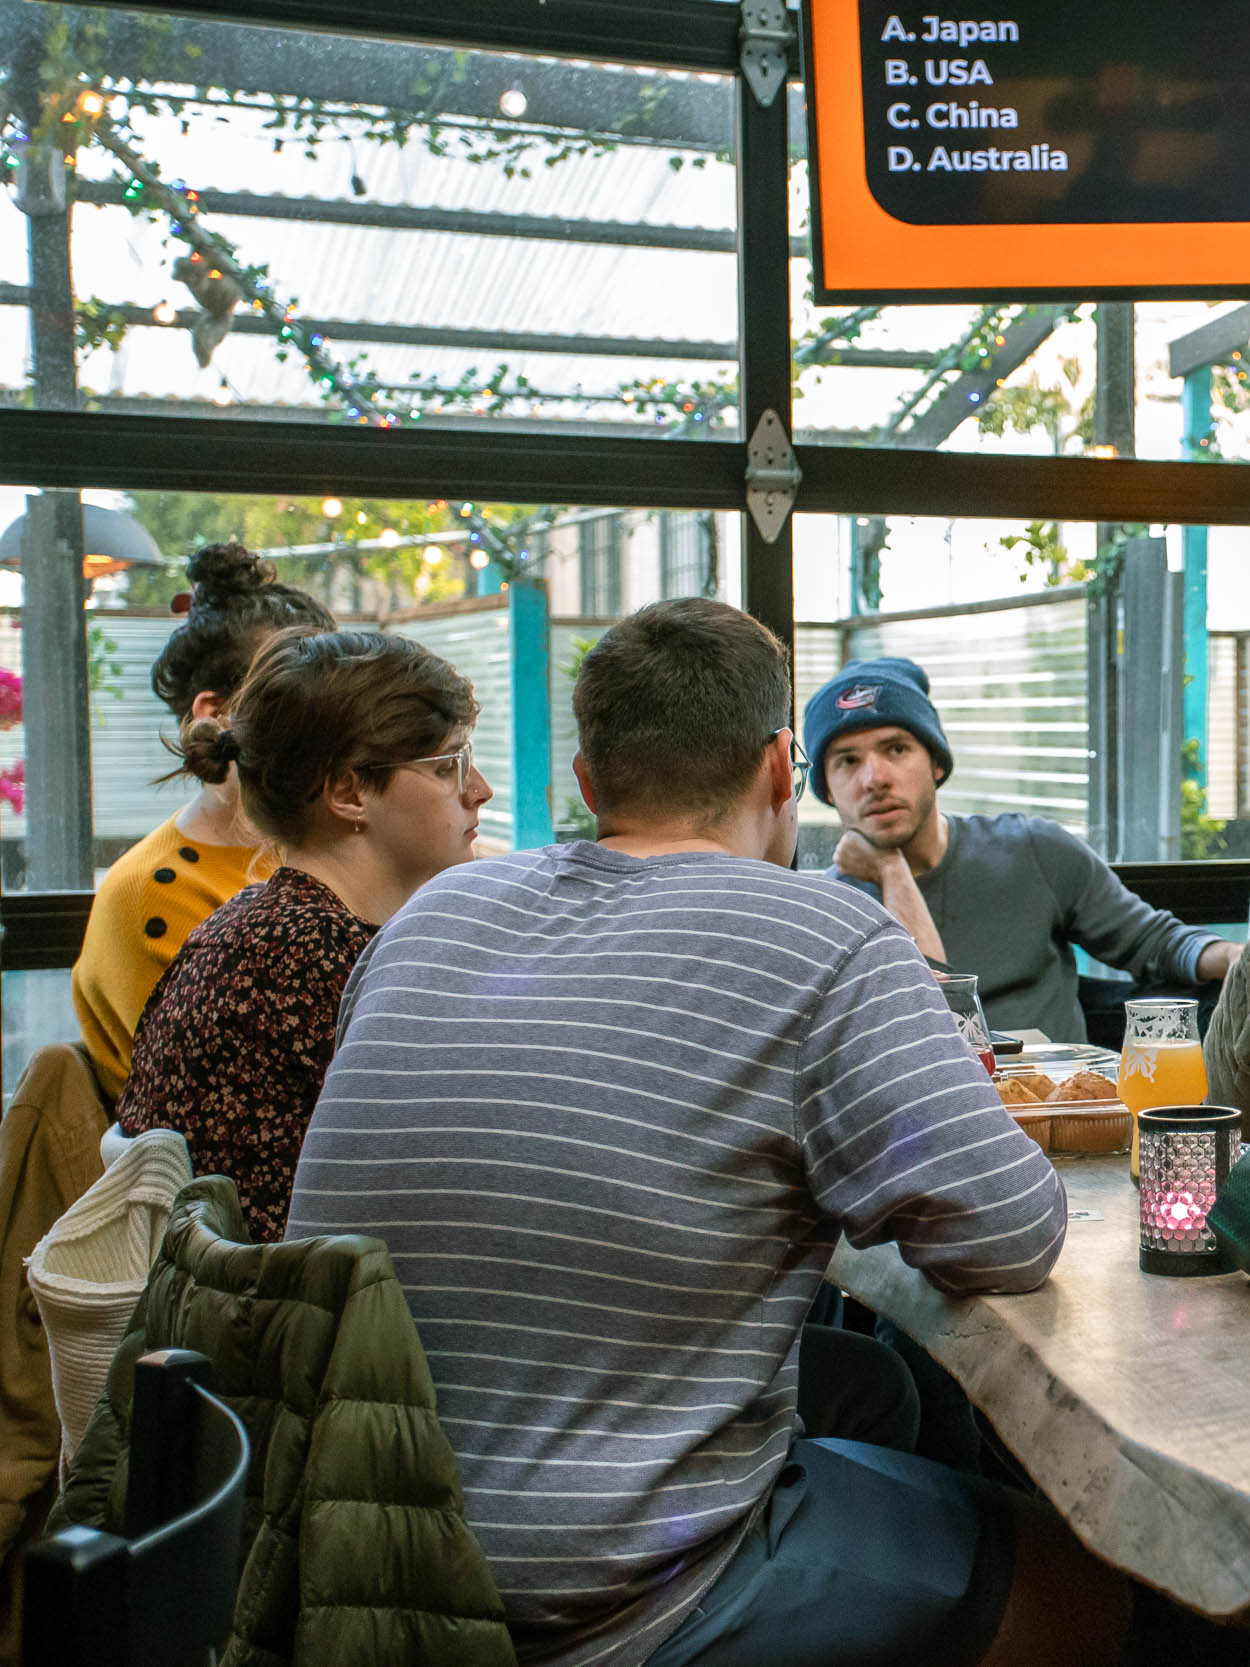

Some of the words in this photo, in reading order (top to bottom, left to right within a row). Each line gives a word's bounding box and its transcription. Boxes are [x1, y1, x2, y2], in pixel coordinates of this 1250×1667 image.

[881, 15, 917, 42] A.
[921, 15, 1019, 47] Japan
[885, 59, 918, 86] B.
[925, 59, 994, 86] USA
[887, 102, 920, 129] C.
[926, 100, 1019, 129] China
[888, 146, 922, 172] D.
[927, 143, 1068, 172] Australia
